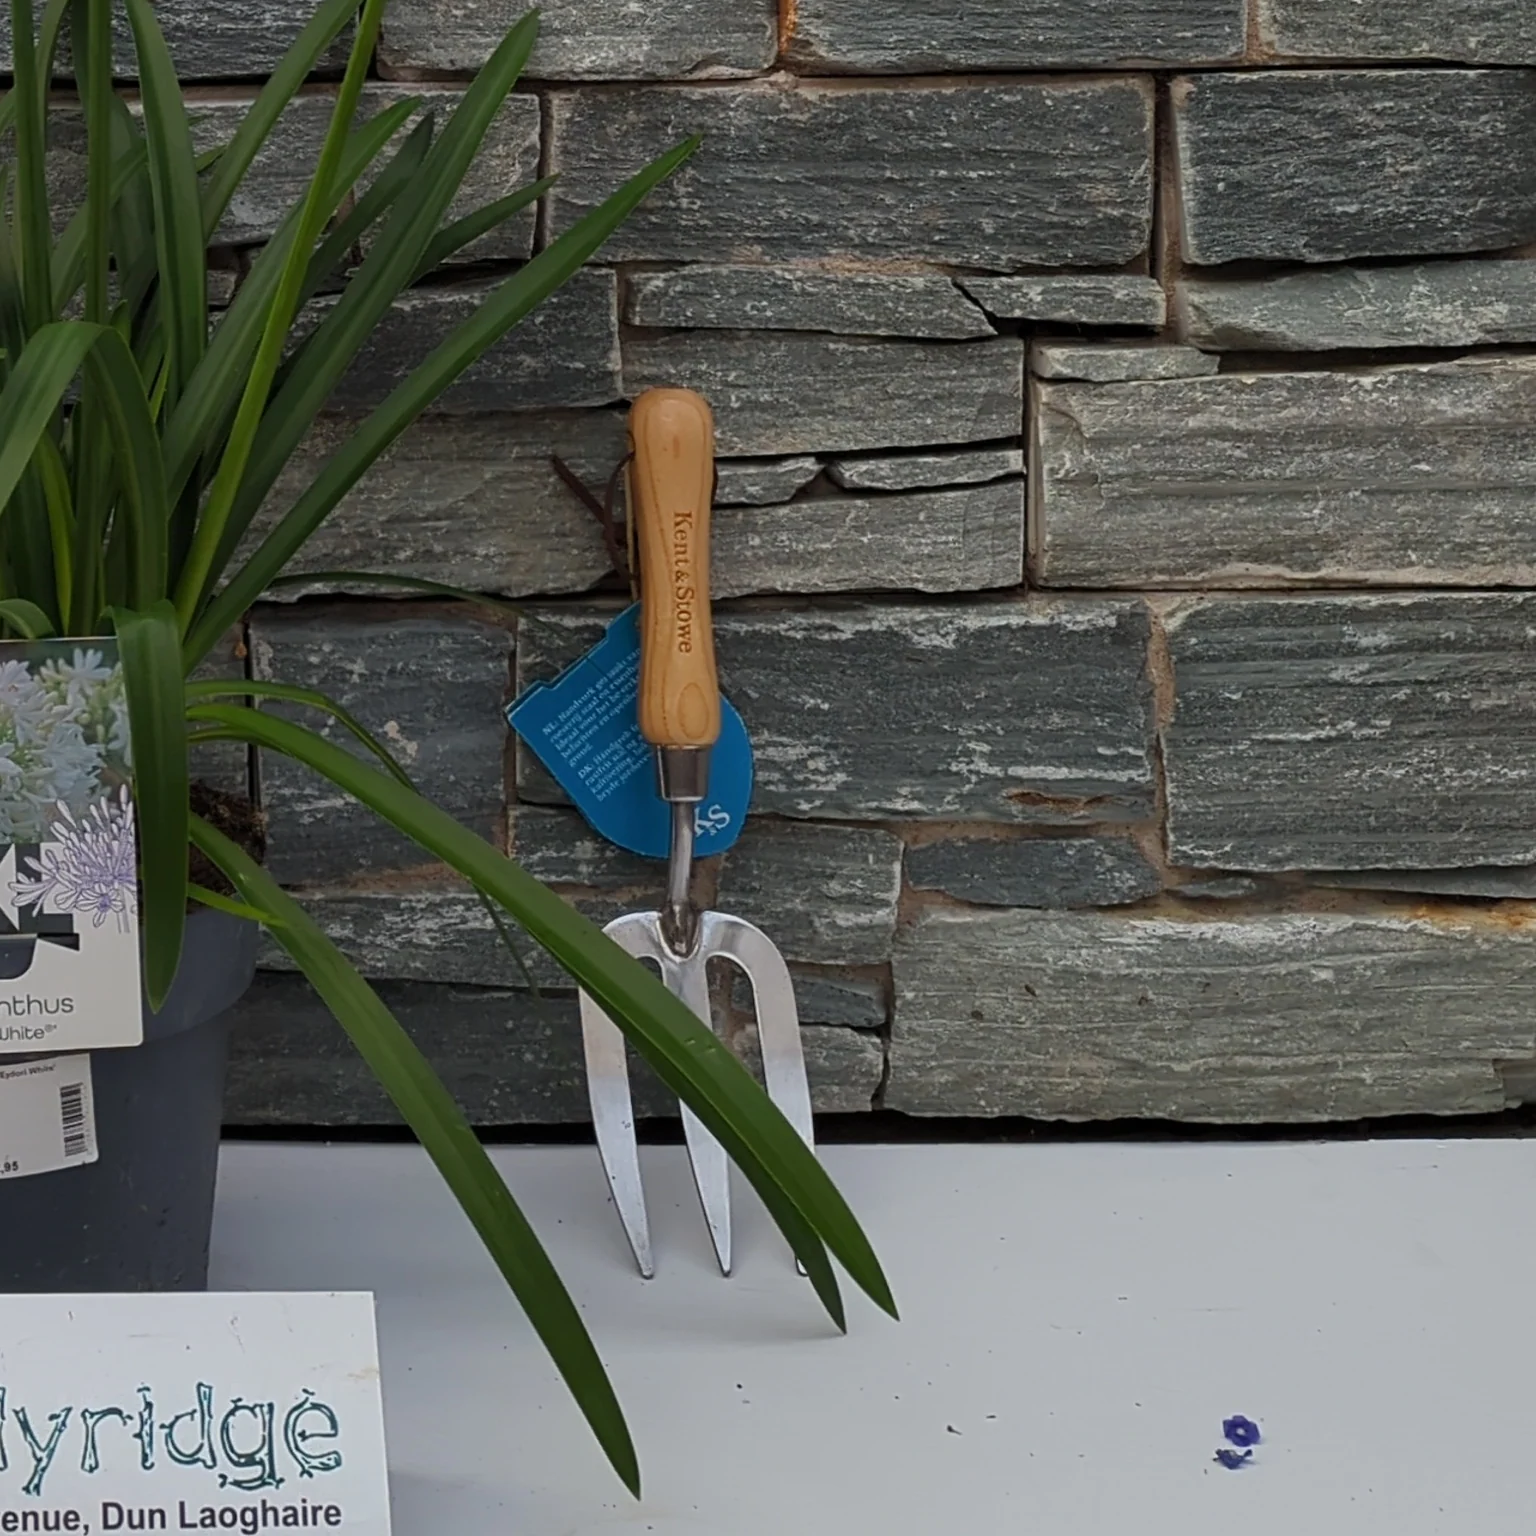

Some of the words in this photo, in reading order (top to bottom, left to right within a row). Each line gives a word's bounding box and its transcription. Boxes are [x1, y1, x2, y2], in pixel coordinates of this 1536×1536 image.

[673, 512, 692, 567] Kent
[675, 570, 690, 583] &
[676, 586, 694, 654] Stowe
[101, 1502, 167, 1530] Dun
[178, 1498, 342, 1535] Laoghaire
